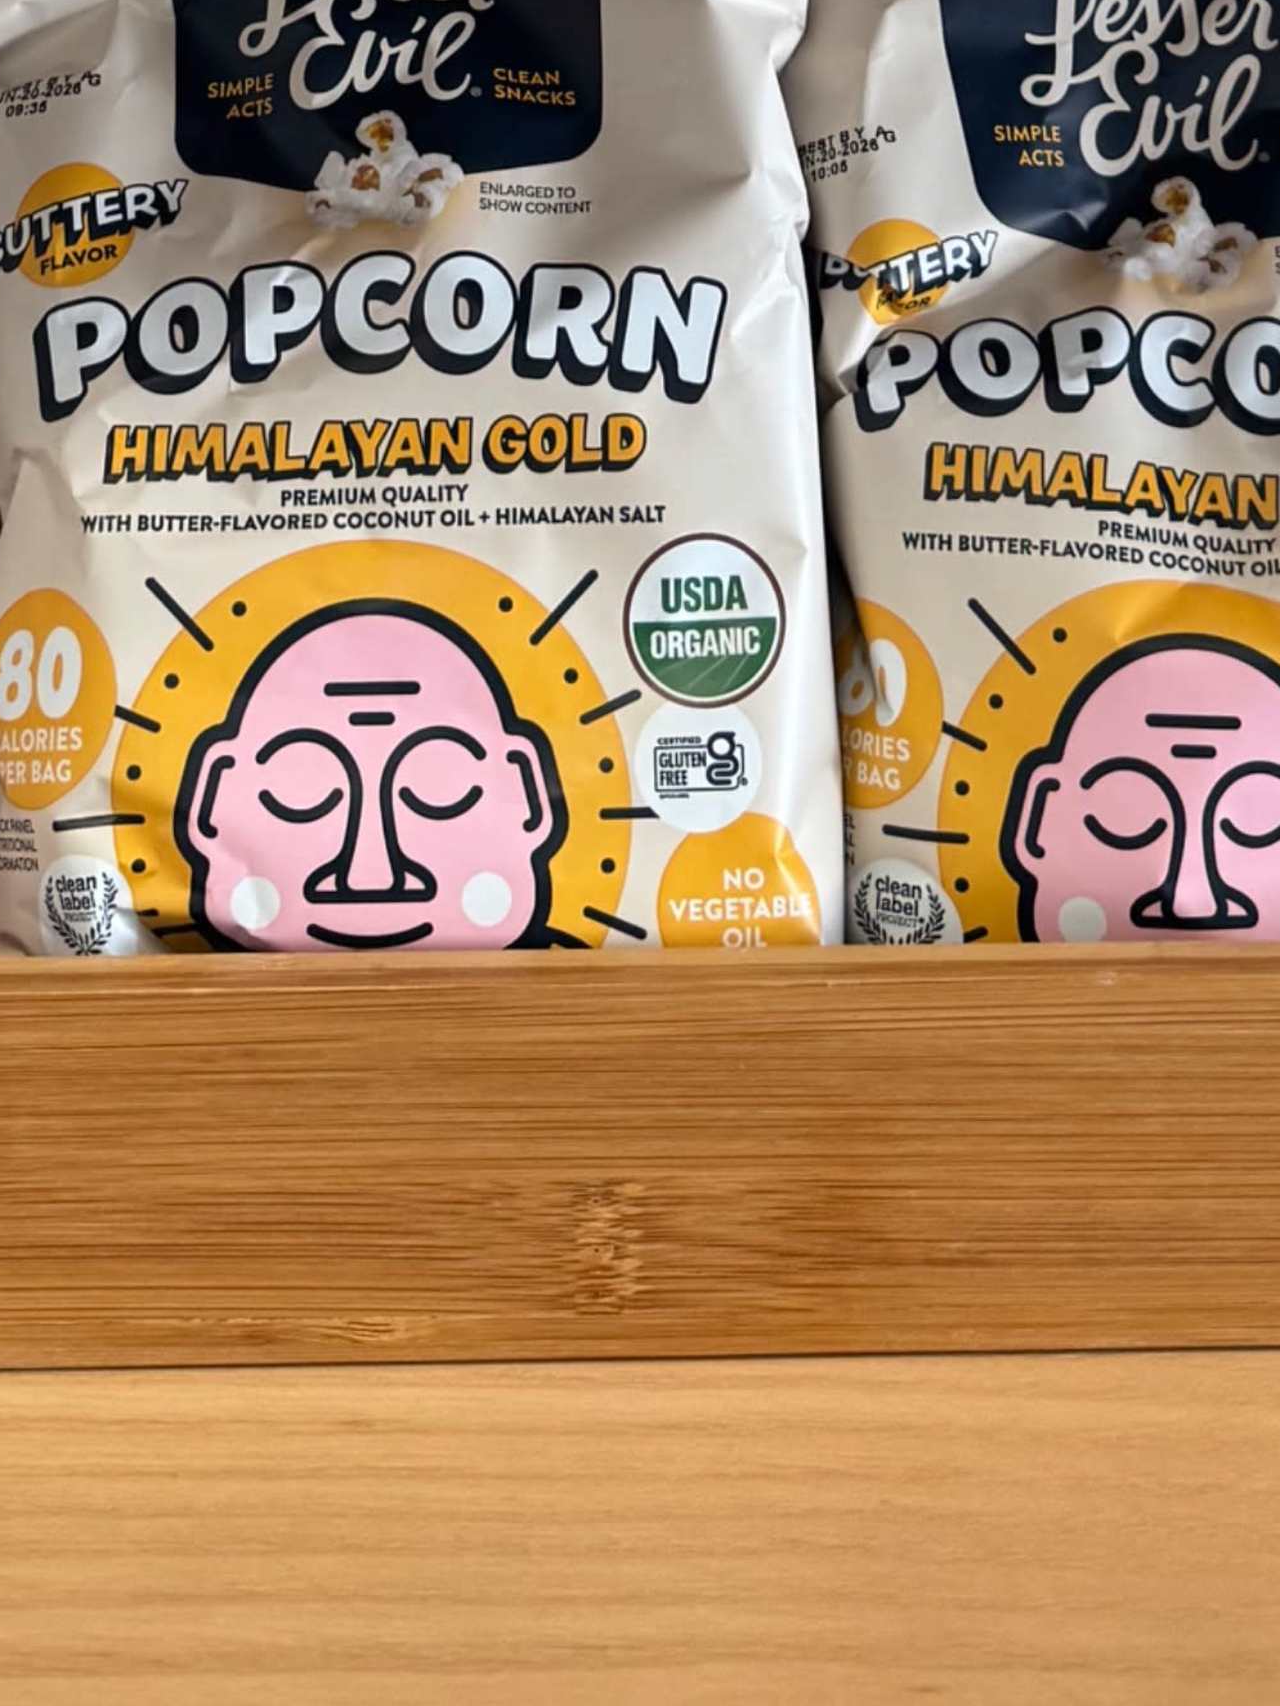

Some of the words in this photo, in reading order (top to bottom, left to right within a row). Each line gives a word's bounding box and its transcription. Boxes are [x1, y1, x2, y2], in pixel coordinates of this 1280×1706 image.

[289, 11, 476, 110] Evil
[207, 72, 274, 99] SIMPLE
[493, 68, 560, 85] CLEAN
[494, 86, 576, 106] SNACKS
[227, 100, 273, 119] ACTS
[1080, 54, 1262, 176] Evil
[994, 125, 1062, 143] SIMPLE
[1019, 150, 1065, 167] ACTS
[480, 182, 554, 199] ENLARGED
[556, 185, 576, 199] TO
[479, 198, 522, 213] SHOW
[524, 201, 591, 214] CONTENT
[40, 244, 118, 276] FLAVOR
[33, 250, 726, 422] POPCORN
[104, 418, 474, 484] HIMALAYAN
[482, 413, 647, 476] GOLD
[281, 488, 376, 508] PREMIUM
[382, 485, 468, 505] QUALITY
[923, 442, 1280, 530] HIMALAYAN
[80, 514, 132, 534] WITH
[137, 511, 328, 533] BUTTER-FLAVORED
[333, 509, 436, 530] COCONUT
[440, 509, 475, 528] OIL
[495, 506, 614, 527] HIMALAYAN
[620, 506, 666, 524] SALT
[1097, 520, 1189, 548] PREMIUM
[1193, 535, 1276, 555] QUALITY
[902, 531, 953, 552] WITH
[958, 535, 1144, 565] BUTTER-FLAVORED
[1148, 551, 1246, 577] COCONUT
[661, 575, 748, 613] USDA
[650, 626, 761, 659] ORGANIC
[0, 761, 26, 785] PER
[32, 759, 72, 784] BAG
[659, 752, 707, 769] GLUTEN
[659, 770, 688, 787] FREE
[856, 762, 901, 790] BAG
[56, 876, 97, 892] clean
[723, 868, 765, 889] NO
[875, 876, 922, 900] clean
[58, 891, 96, 911] label
[876, 891, 919, 917] label
[723, 927, 767, 948] OIL
